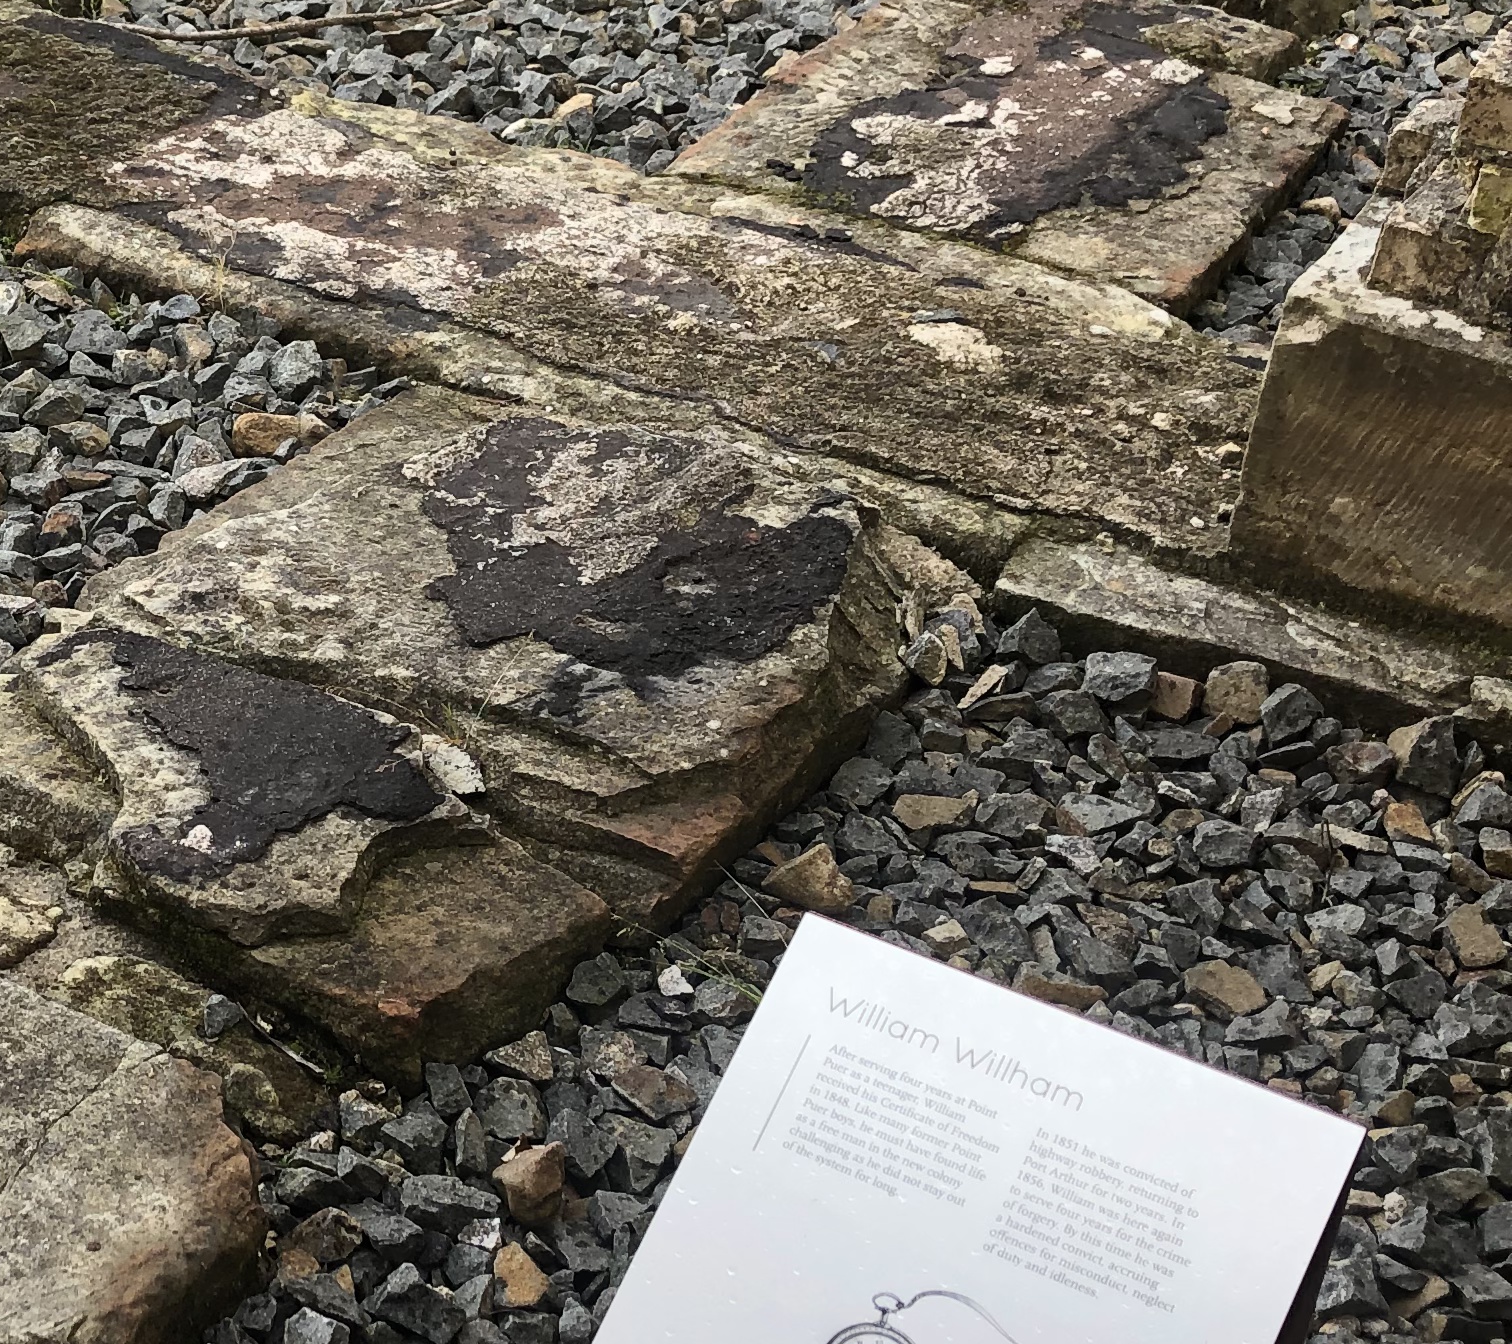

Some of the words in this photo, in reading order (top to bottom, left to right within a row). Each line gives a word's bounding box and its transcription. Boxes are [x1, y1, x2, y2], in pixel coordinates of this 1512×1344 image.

[828, 1043, 858, 1062] After
[858, 1057, 899, 1081] serving
[899, 1071, 923, 1088] four
[923, 1083, 953, 1101] years
[954, 1096, 966, 1106] at
[967, 1099, 998, 1120] Point
[829, 986, 940, 1054] William
[956, 1036, 1084, 1112] Willham
[809, 1084, 821, 1096] in
[878, 1114, 910, 1134] many
[911, 1125, 949, 1149] former
[951, 1142, 982, 1163] Point
[815, 1072, 861, 1096] received
[860, 1088, 878, 1104] his
[880, 1097, 935, 1126] Certificate
[937, 1122, 950, 1132] of
[950, 1125, 1000, 1154] Freedom
[822, 1056, 849, 1075] Puer
[849, 1070, 863, 1080] as
[863, 1075, 871, 1084] a
[925, 1097, 966, 1123] William
[782, 1141, 796, 1151] of
[795, 1144, 814, 1159] the
[814, 1155, 853, 1176] system
[854, 1169, 870, 1184] for
[789, 1126, 851, 1161] challenging
[852, 1154, 865, 1164] as
[866, 1156, 881, 1171] he
[882, 1164, 902, 1180] did
[902, 1174, 922, 1188] not
[922, 1183, 945, 1200] stay
[946, 1193, 966, 1208] out
[795, 1113, 808, 1124] as
[809, 1119, 816, 1127] a
[818, 1120, 840, 1137] free
[841, 1132, 866, 1148] man
[868, 1142, 880, 1154] in
[882, 1147, 900, 1162] the
[901, 1157, 926, 1172] new
[926, 1168, 963, 1190] colony
[802, 1097, 829, 1116] Puer
[859, 1120, 874, 1134] he
[875, 1130, 905, 1147] must
[905, 1139, 932, 1158] have
[933, 1151, 968, 1174] found
[967, 1165, 987, 1182] life
[1035, 1127, 1050, 1141] In
[1053, 1134, 1079, 1152] 1851
[1081, 1144, 1097, 1160] he
[1099, 1154, 1121, 1170] was
[1123, 1165, 1180, 1193] convicted
[1180, 1188, 1197, 1199] of
[1022, 1155, 1047, 1174] Port
[1048, 1167, 1089, 1190] Arthur
[1090, 1183, 1109, 1198] for
[1110, 1193, 1133, 1208] two
[1171, 1216, 1185, 1231] In
[1028, 1140, 1078, 1170] highway
[1128, 1184, 1185, 1215] returning
[1186, 1207, 1200, 1219] to
[1051, 1183, 1095, 1210] William
[1098, 1205, 1120, 1220] was
[1122, 1212, 1149, 1232] here
[1151, 1228, 1184, 1247] again
[982, 1243, 999, 1254] of
[996, 1247, 1023, 1267] duty
[1024, 1261, 1049, 1277] and
[995, 1214, 1003, 1223] a
[1005, 1215, 1061, 1247] hardened
[1107, 1262, 1160, 1292] accruing
[1002, 1200, 1017, 1211] of
[1063, 1223, 1078, 1238] By
[1080, 1231, 1102, 1248] this
[1104, 1241, 1132, 1260] time
[1134, 1252, 1149, 1267] he
[1152, 1262, 1175, 1278] was
[1009, 1184, 1022, 1196] to
[1023, 1192, 1054, 1210] serve
[1055, 1203, 1081, 1220] four
[1081, 1216, 1113, 1234] years
[1115, 1227, 1133, 1243] for
[1135, 1236, 1155, 1252] the
[1156, 1247, 1192, 1268] crime
[989, 1229, 1037, 1254] offences
[1039, 1247, 1056, 1262] for
[1131, 1289, 1176, 1314] neglect
